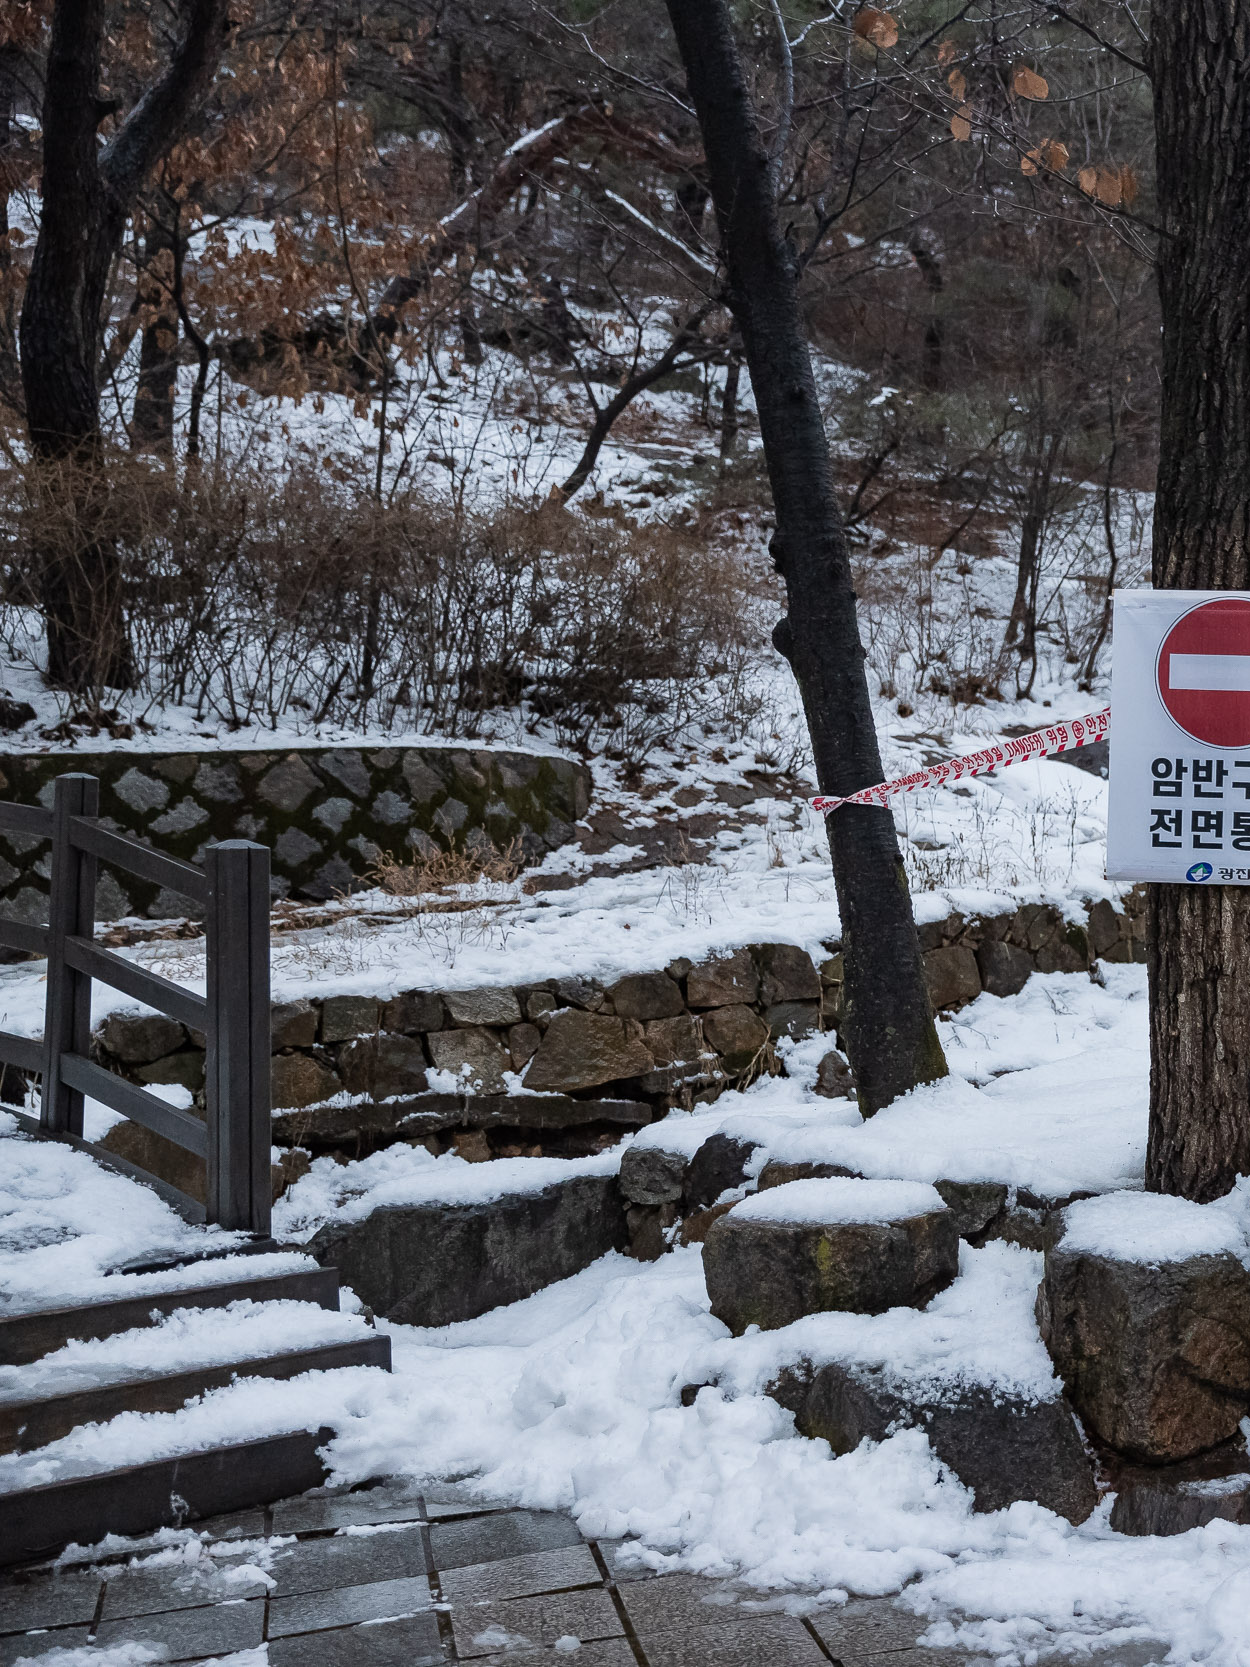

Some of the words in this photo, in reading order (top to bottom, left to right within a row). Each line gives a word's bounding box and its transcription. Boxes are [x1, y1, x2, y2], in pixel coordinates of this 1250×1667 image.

[962, 746, 1003, 770] 안전제일
[1046, 725, 1068, 746] 위험
[1086, 712, 1111, 735] 안전
